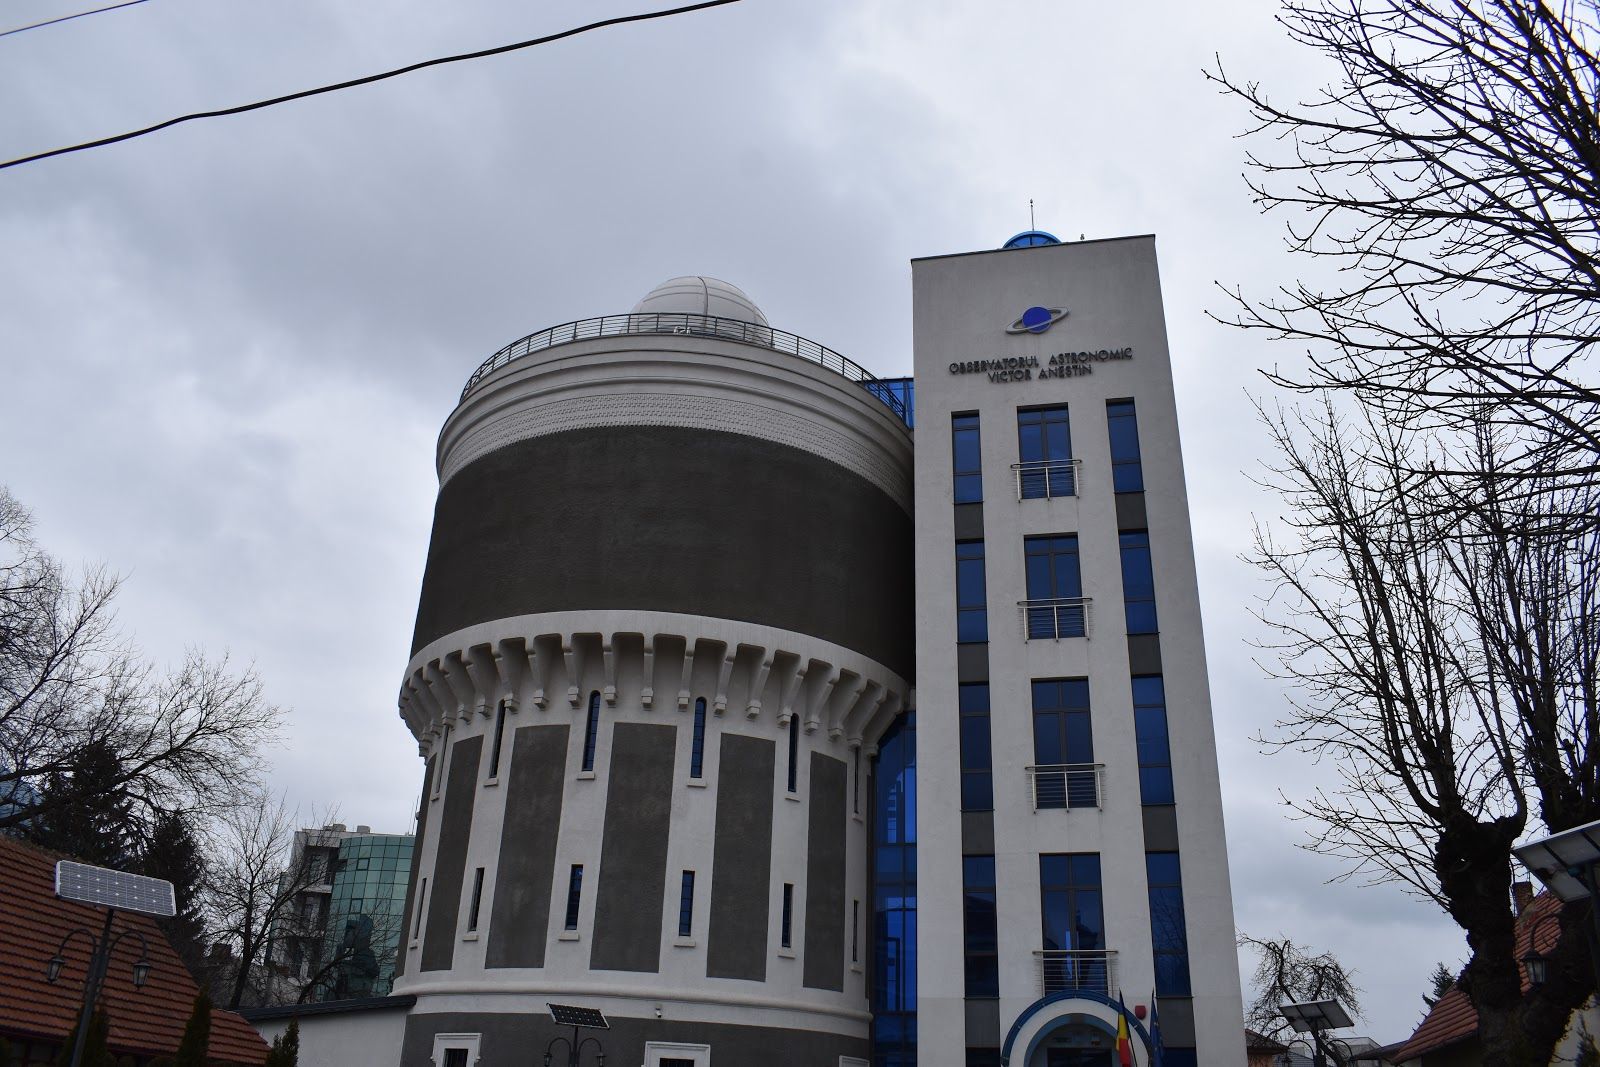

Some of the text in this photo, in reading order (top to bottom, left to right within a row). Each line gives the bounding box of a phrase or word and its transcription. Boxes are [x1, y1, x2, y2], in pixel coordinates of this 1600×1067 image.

[949, 347, 1133, 374] OBSERVATORUL ASTRONOMIC
[987, 364, 1092, 383] VICTOR ANESTIN
